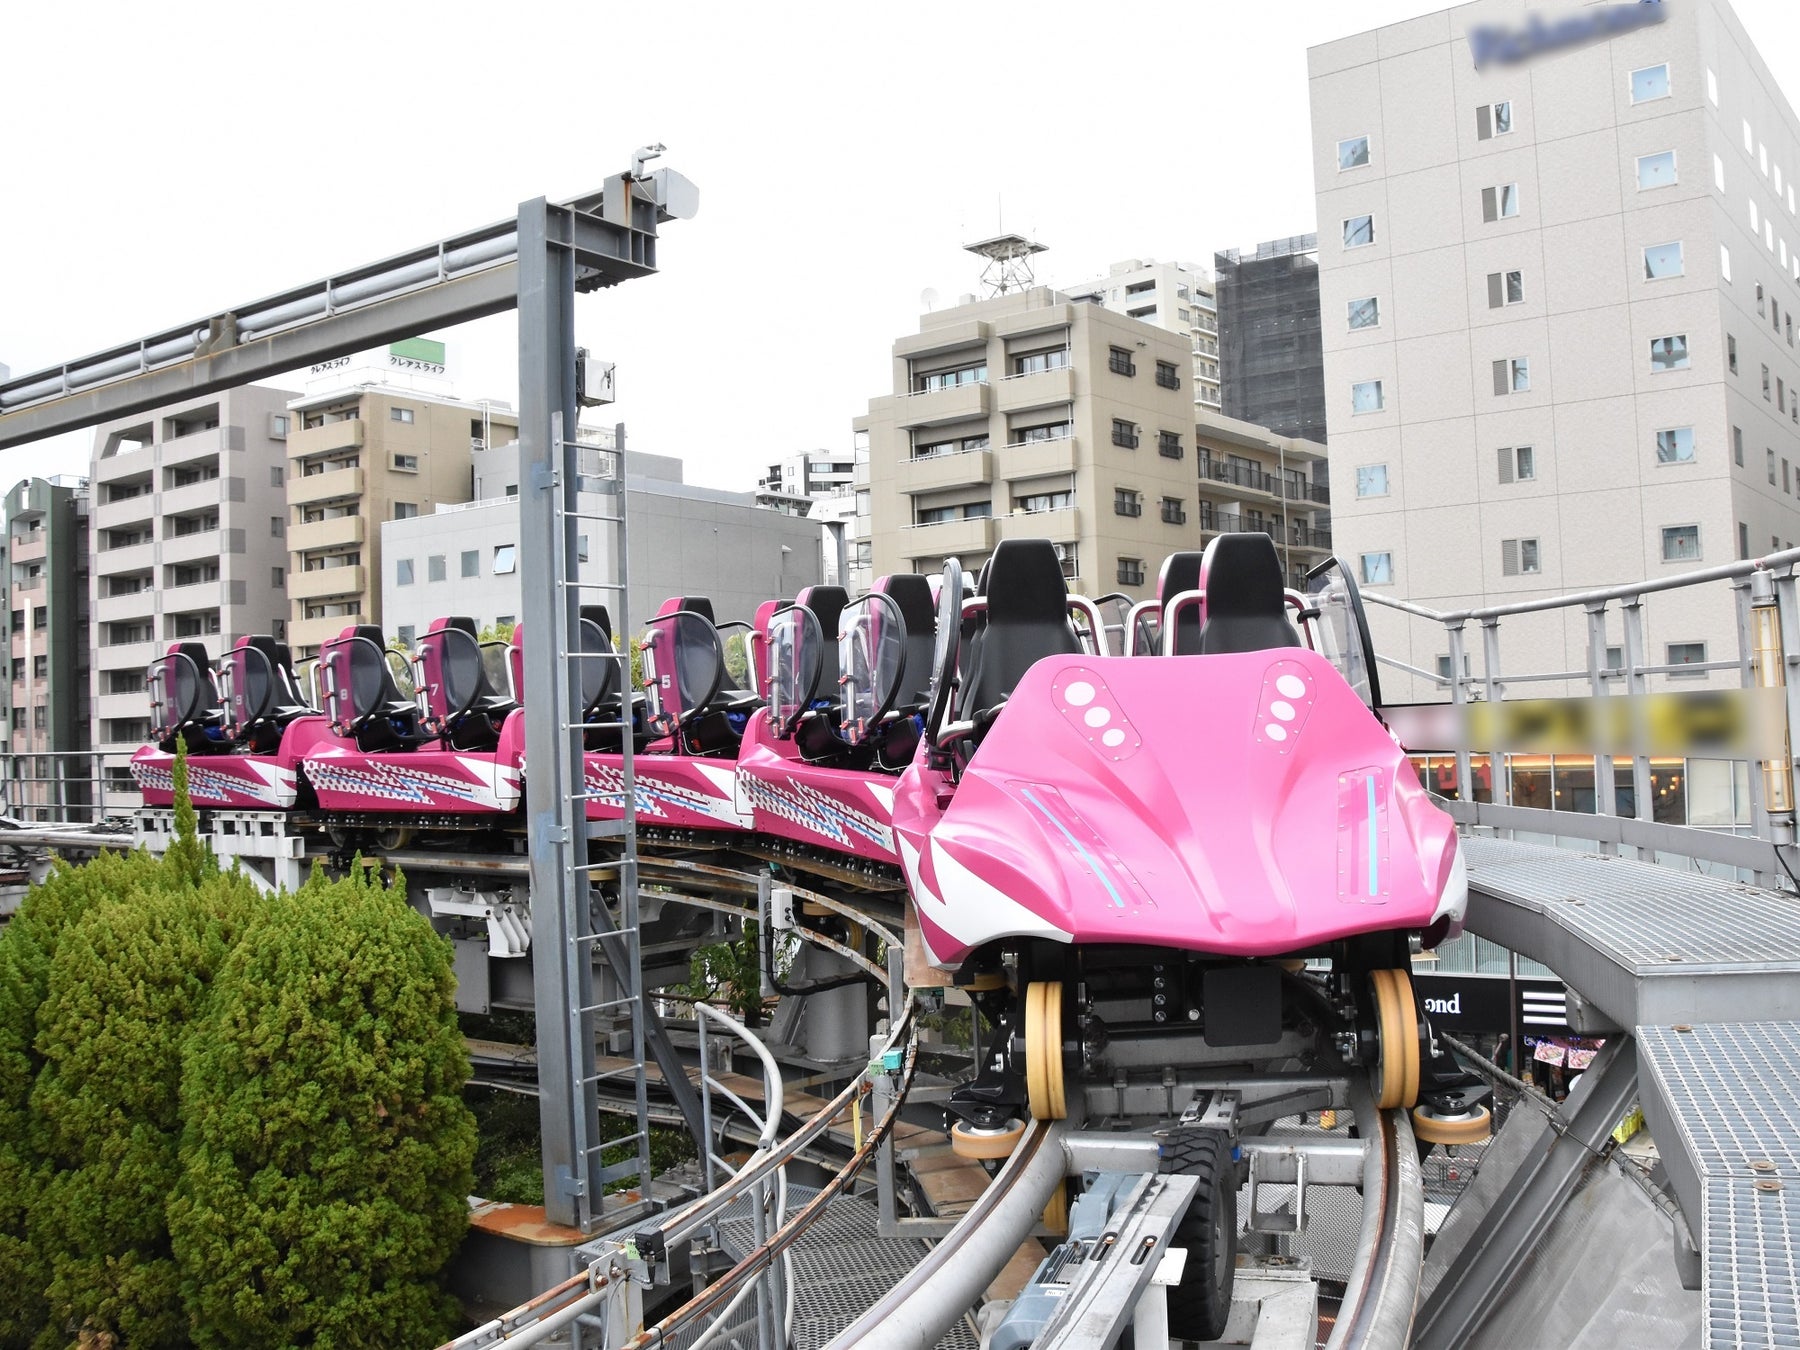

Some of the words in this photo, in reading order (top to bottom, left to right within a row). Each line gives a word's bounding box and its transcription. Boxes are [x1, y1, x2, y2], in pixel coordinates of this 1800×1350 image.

[310, 356, 350, 374] クレアスライフ
[390, 356, 445, 374] クレアスライフ
[430, 683, 439, 696] 7
[661, 674, 671, 689] 5
